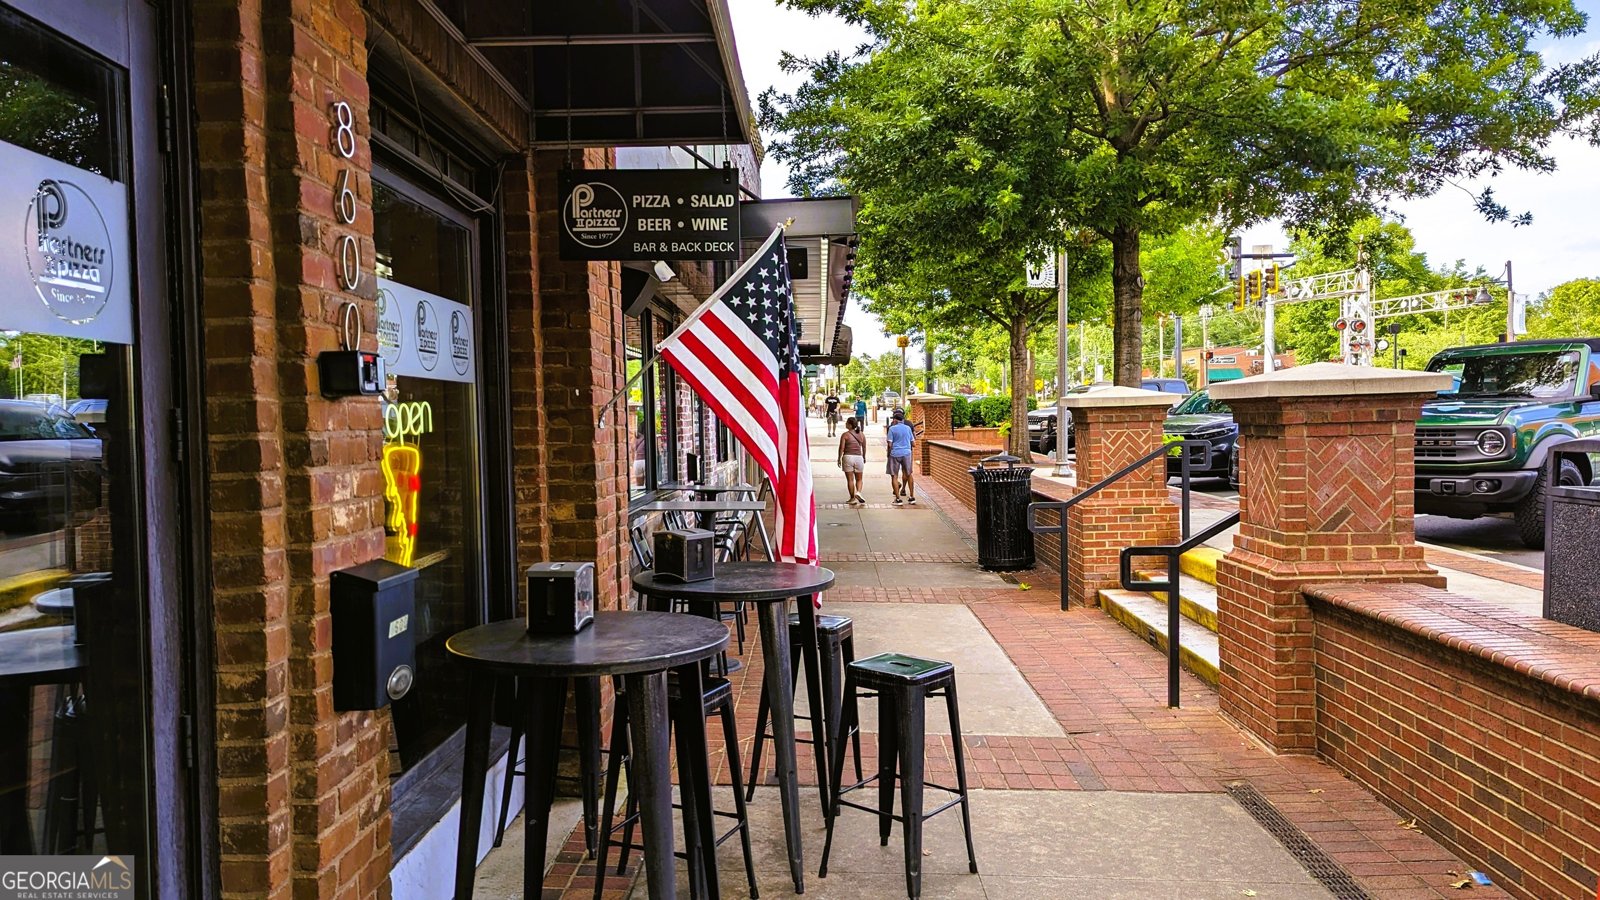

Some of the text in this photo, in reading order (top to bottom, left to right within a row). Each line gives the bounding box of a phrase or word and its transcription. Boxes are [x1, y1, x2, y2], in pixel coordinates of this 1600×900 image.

[572, 184, 622, 218] Partners
[632, 194, 735, 208] PIZZA SALAD
[336, 101, 361, 351] 8600
[585, 219, 617, 229] pizza
[638, 217, 728, 231] BEER WINE
[633, 242, 735, 252] BAR & BACK DECK
[385, 401, 433, 447] open
